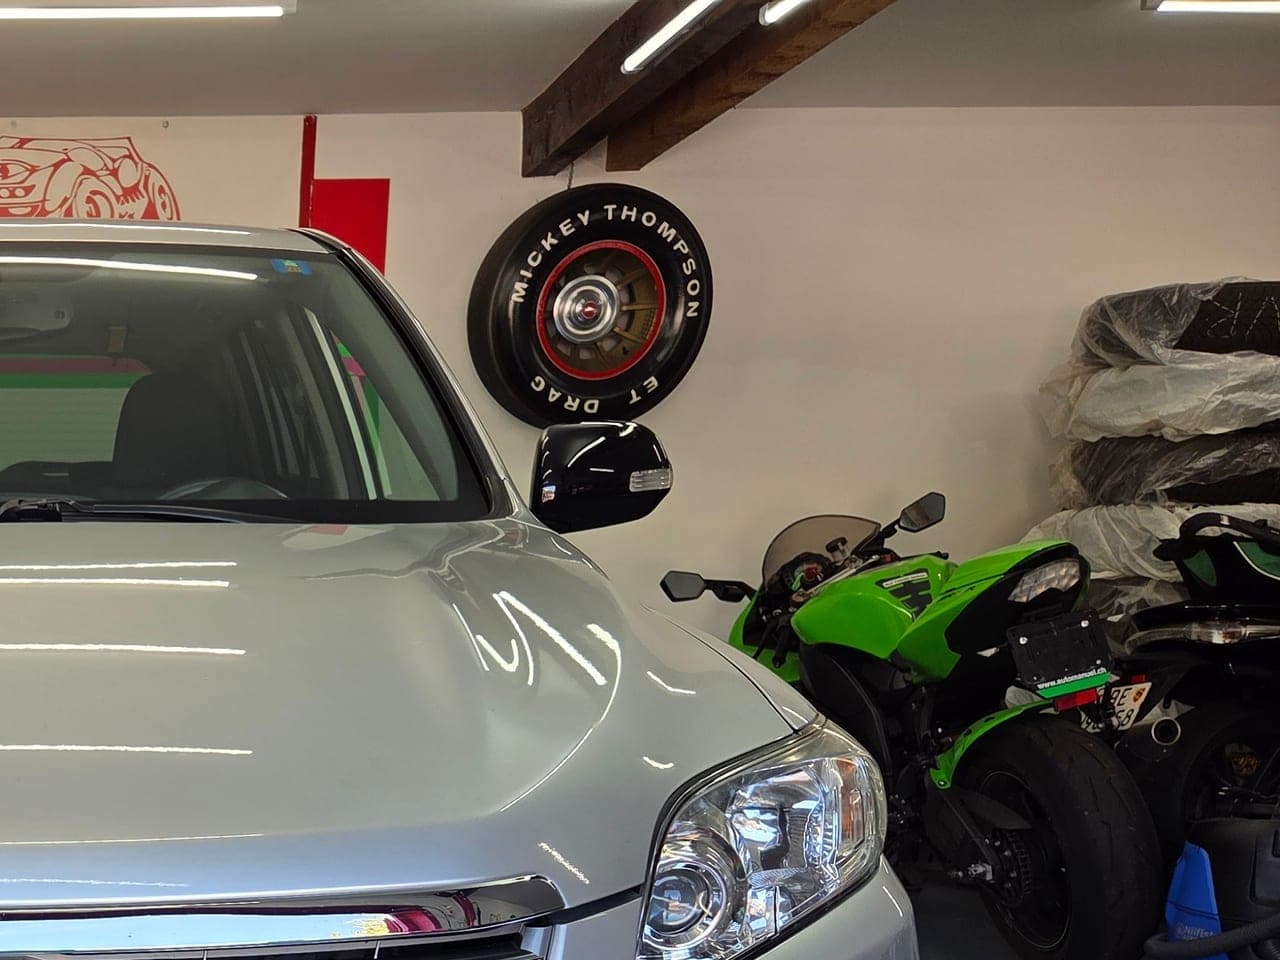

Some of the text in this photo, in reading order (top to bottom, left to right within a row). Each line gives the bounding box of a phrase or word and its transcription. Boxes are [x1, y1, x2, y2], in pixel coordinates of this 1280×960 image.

[512, 204, 701, 318] MICKEY THOMPSON
[530, 375, 659, 414] ET DRAG
[1037, 666, 1107, 690] www.automanuel.ch
